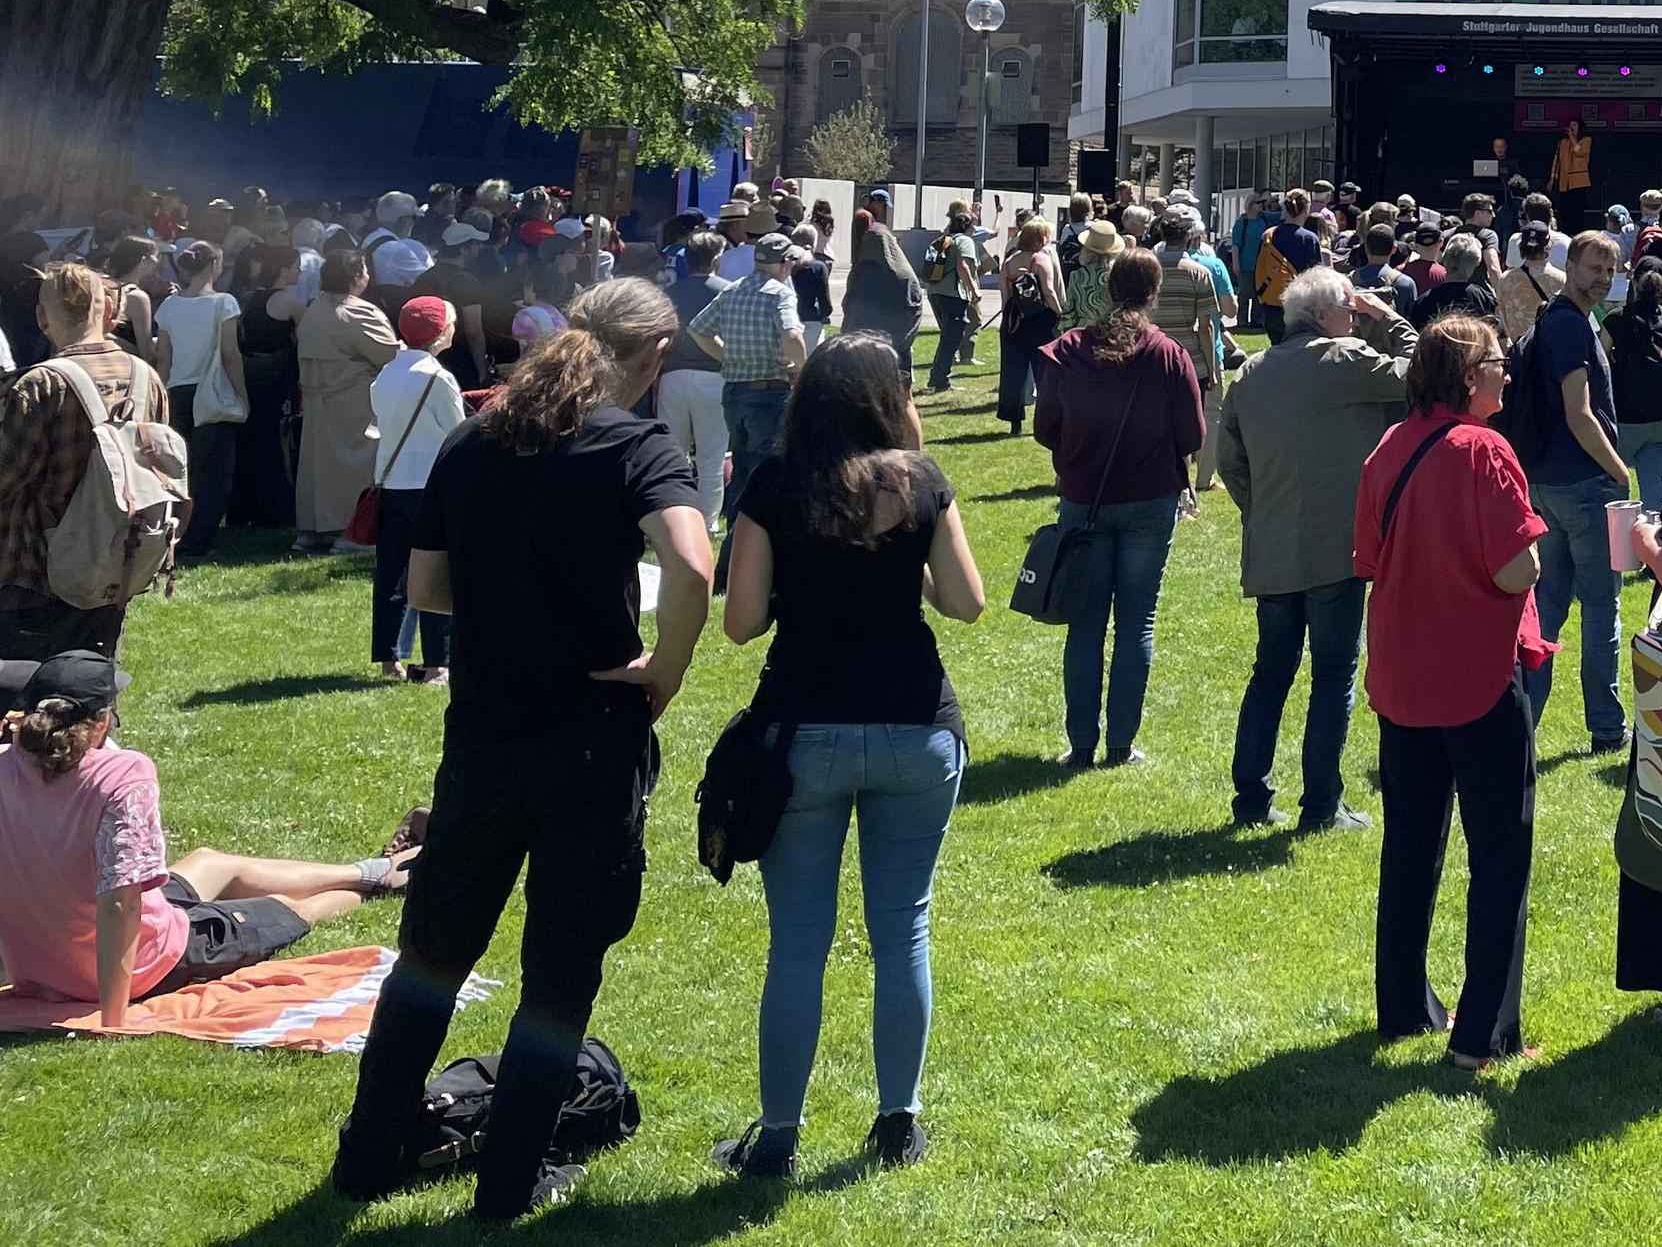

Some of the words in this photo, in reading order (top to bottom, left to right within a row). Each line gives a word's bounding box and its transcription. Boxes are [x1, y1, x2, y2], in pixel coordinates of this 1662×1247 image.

[1462, 20, 1520, 33] Stuttgarter
[1525, 22, 1590, 34] Jugendhaus
[1593, 23, 1660, 34] Gesellschaft
